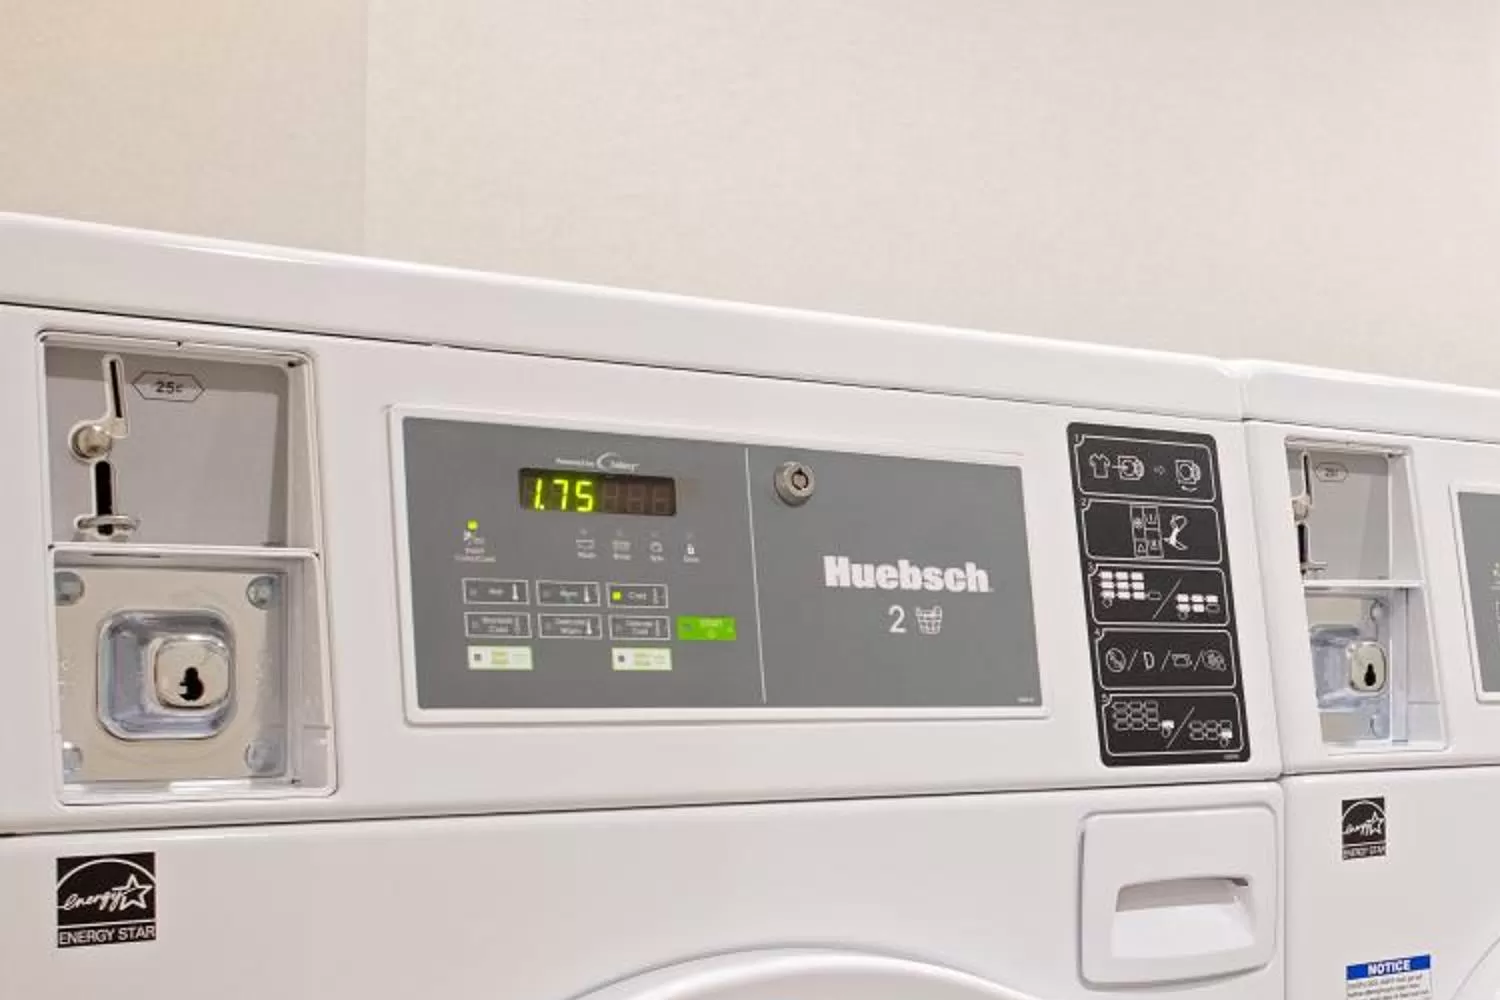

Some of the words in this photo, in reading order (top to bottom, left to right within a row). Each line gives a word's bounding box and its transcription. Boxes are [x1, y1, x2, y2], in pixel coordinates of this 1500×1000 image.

[533, 478, 594, 513] 1.75
[823, 555, 990, 592] Huebsch
[888, 604, 907, 634] 2
[60, 928, 115, 945] ENERGY
[117, 925, 156, 941] STAR
[1367, 959, 1411, 975] NOTICE
